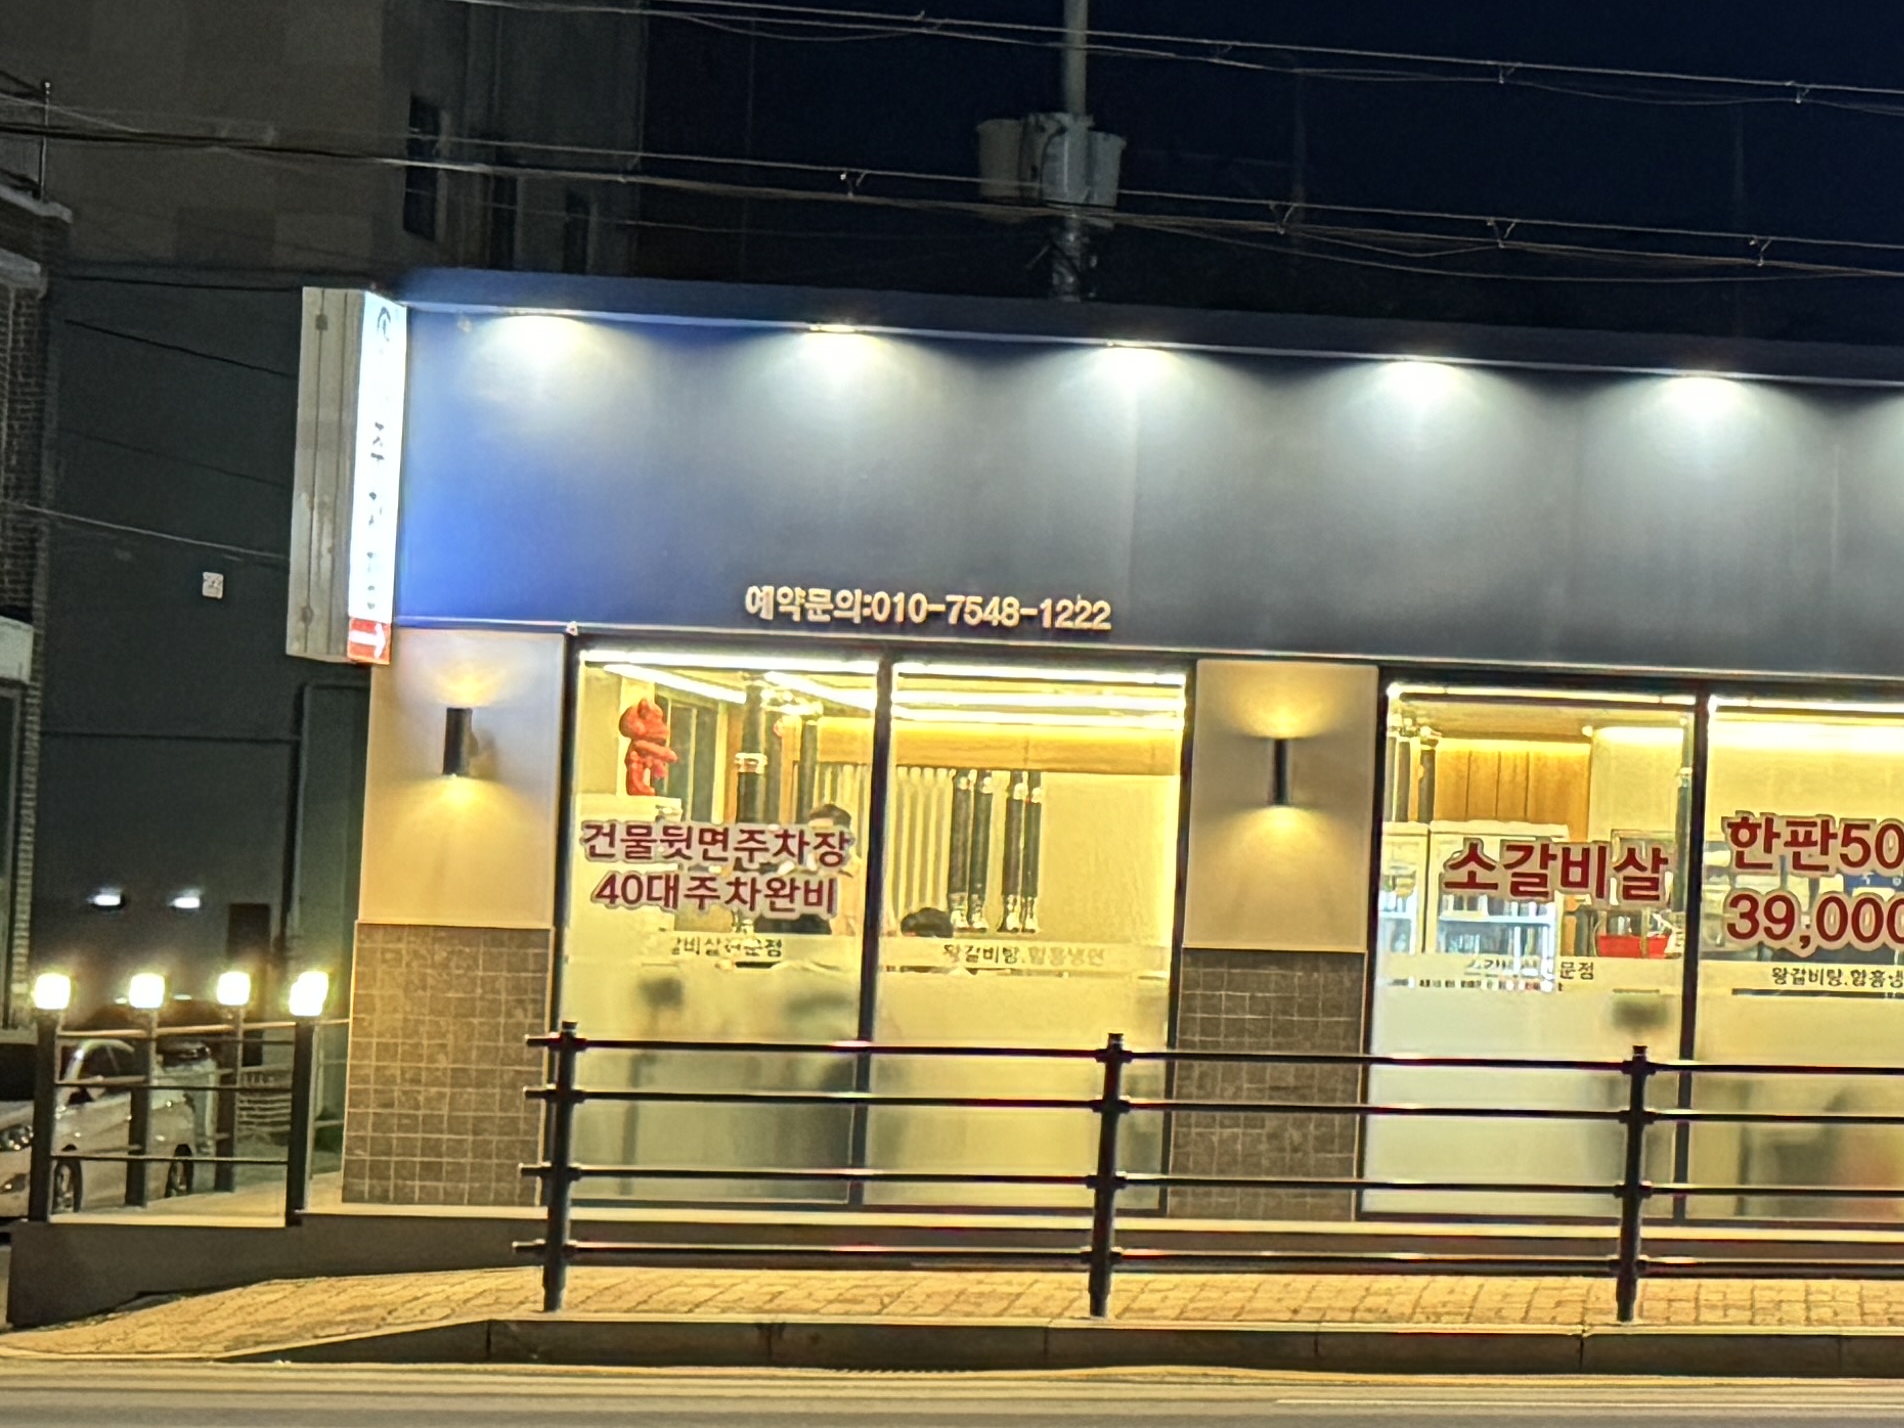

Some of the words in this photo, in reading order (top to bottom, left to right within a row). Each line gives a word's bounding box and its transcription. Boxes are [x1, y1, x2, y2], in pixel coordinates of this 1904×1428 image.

[745, 584, 1112, 631] 예약문의:010-7548-1222
[582, 821, 849, 868] 건물뒷면주차장
[594, 873, 838, 914] 40대주차완비
[1443, 840, 1668, 902] 소갈비살
